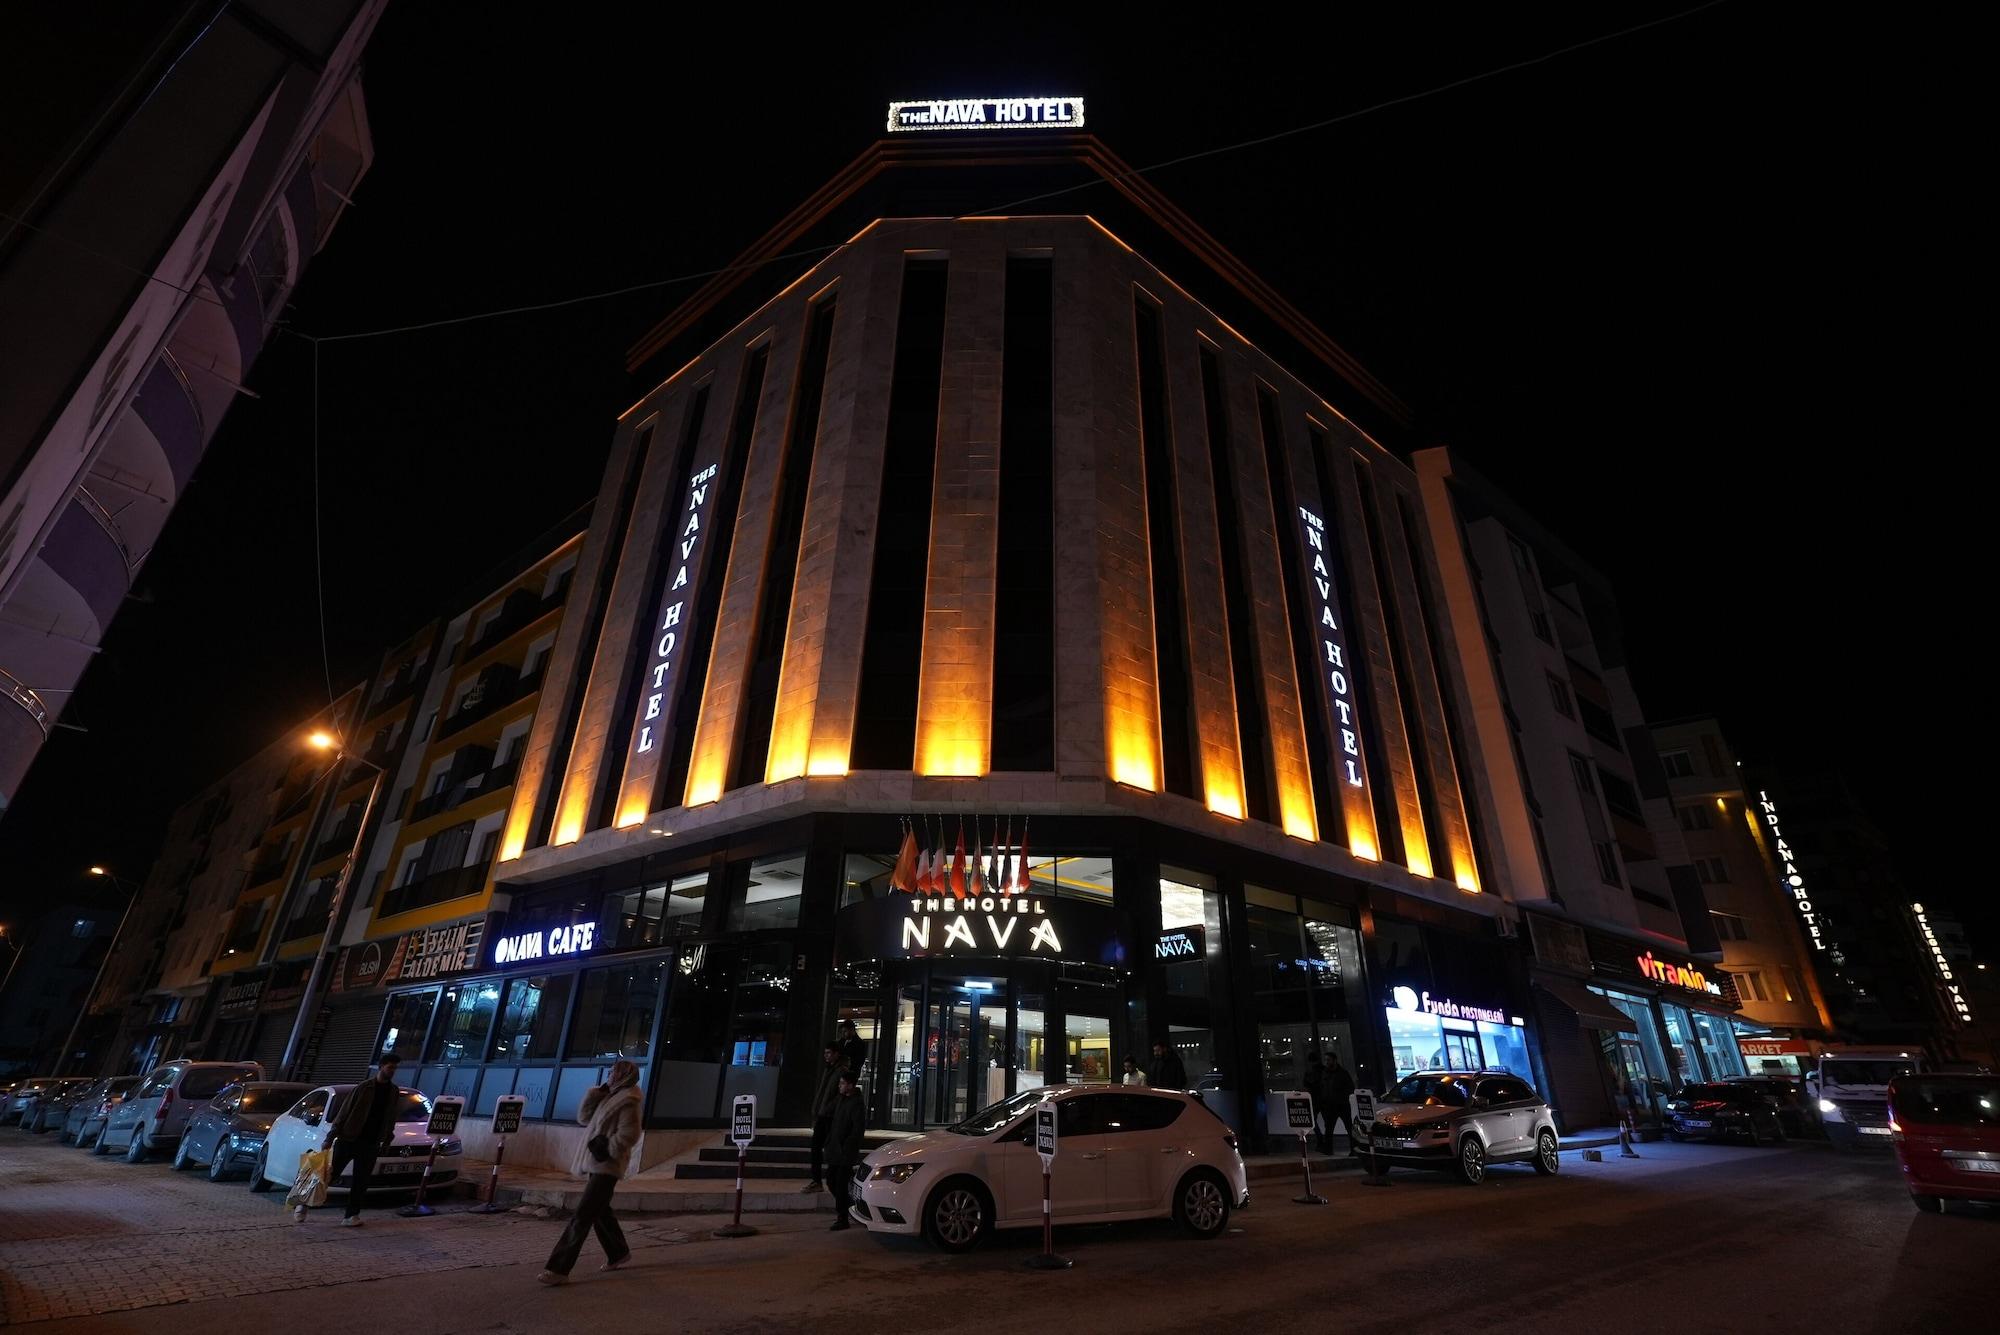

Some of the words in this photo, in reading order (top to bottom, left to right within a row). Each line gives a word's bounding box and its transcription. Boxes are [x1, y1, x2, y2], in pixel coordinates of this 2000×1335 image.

[899, 112, 930, 123] THE
[929, 103, 986, 123] NAVA
[995, 101, 1071, 122] HOTEL
[691, 463, 717, 487] THE
[1299, 506, 1324, 531] THE
[672, 484, 708, 591] NAVA
[1306, 525, 1338, 630] NAVA
[638, 601, 684, 753] HOTEL
[1324, 639, 1363, 788] HOTEL
[1759, 790, 1798, 875] INDIANA
[1793, 888, 1826, 951] HOTEL
[911, 897, 956, 913] THE
[963, 897, 1046, 914] HOTEL
[548, 922, 596, 955] CAFE
[901, 914, 1062, 953] NAVA
[1155, 938, 1195, 959] NAVA
[1421, 991, 1460, 1017] Funda
[1740, 1043, 1783, 1055] ARKET
[430, 1121, 455, 1131] NAVA
[735, 1115, 752, 1124] HOTEL
[735, 1124, 752, 1135] NAVA
[1290, 1115, 1311, 1124] NAVA
